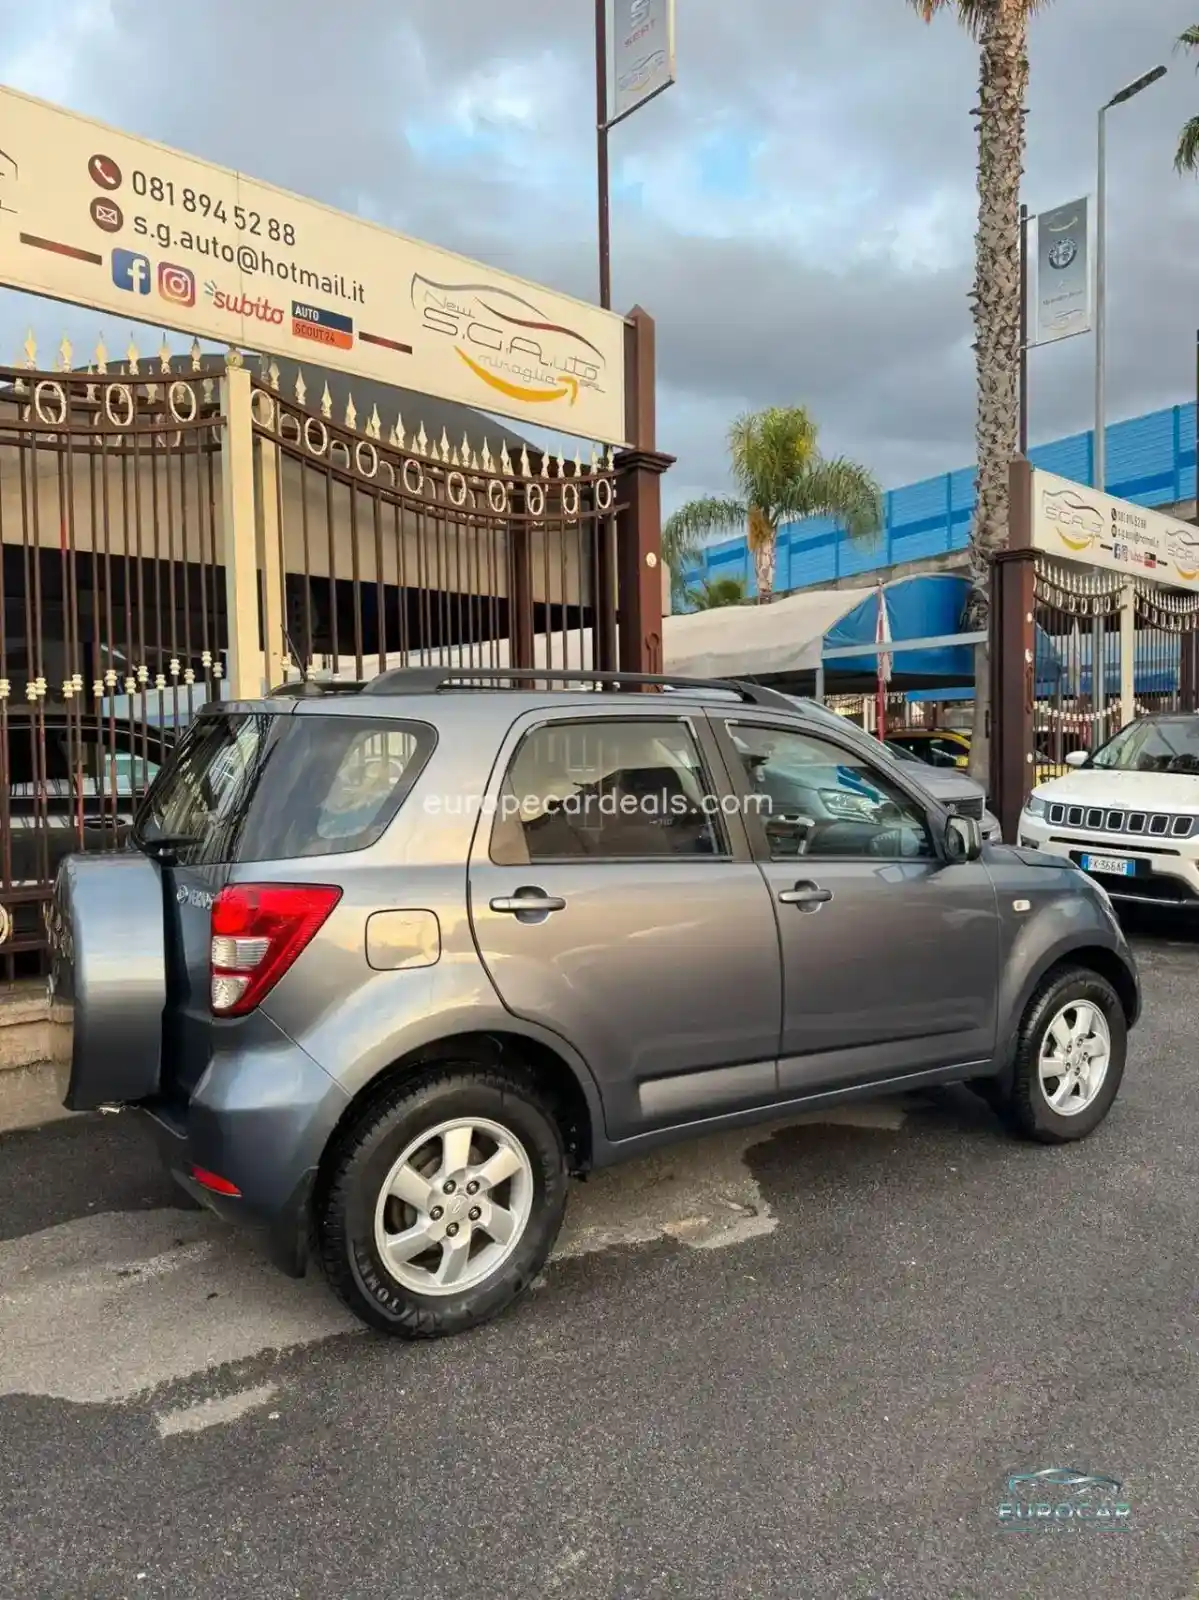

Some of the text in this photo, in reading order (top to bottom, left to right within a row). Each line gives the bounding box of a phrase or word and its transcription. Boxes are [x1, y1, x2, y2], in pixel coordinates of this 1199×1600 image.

[134, 216, 365, 304] s.g.auto@hotmail.it
[212, 287, 284, 325] subito
[295, 305, 320, 321] AUTO
[423, 289, 476, 319] New
